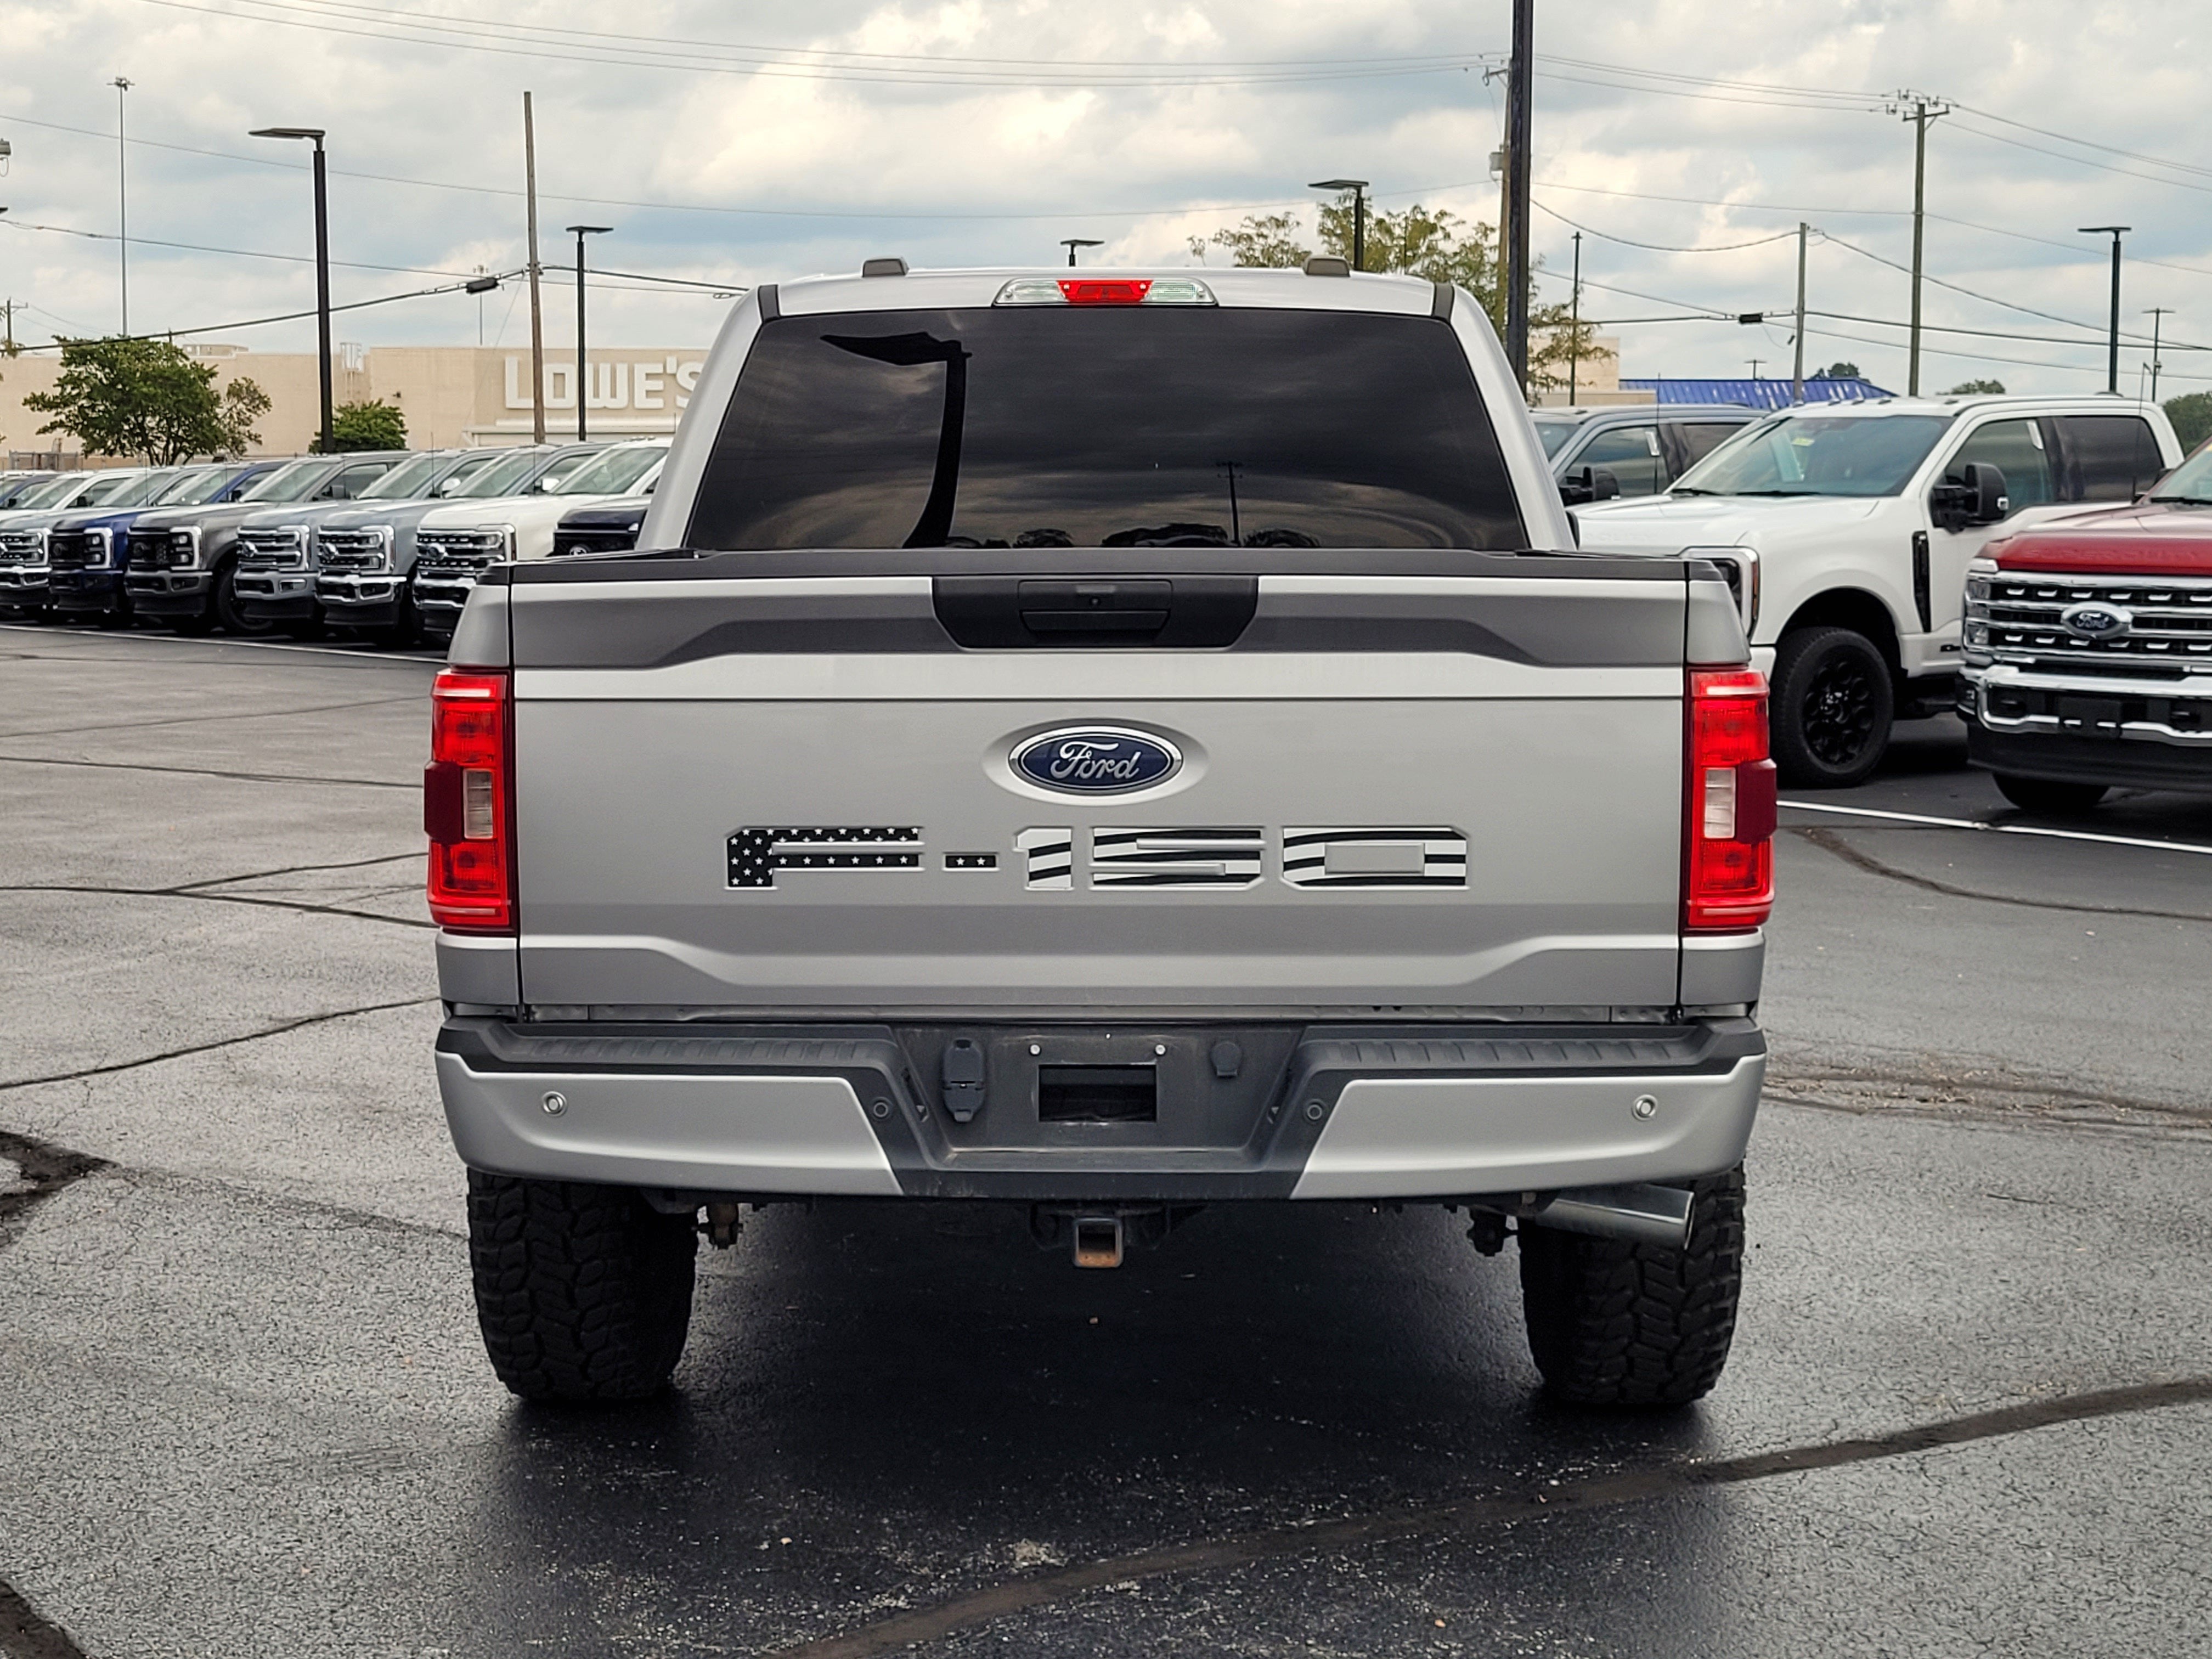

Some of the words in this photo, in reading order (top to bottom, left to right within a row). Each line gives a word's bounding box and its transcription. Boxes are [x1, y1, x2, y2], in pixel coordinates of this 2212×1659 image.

[505, 356, 704, 409] LOWE'S
[2076, 612, 2109, 629] Ford
[1050, 741, 1141, 780] Ford
[725, 826, 1468, 890] F-150
